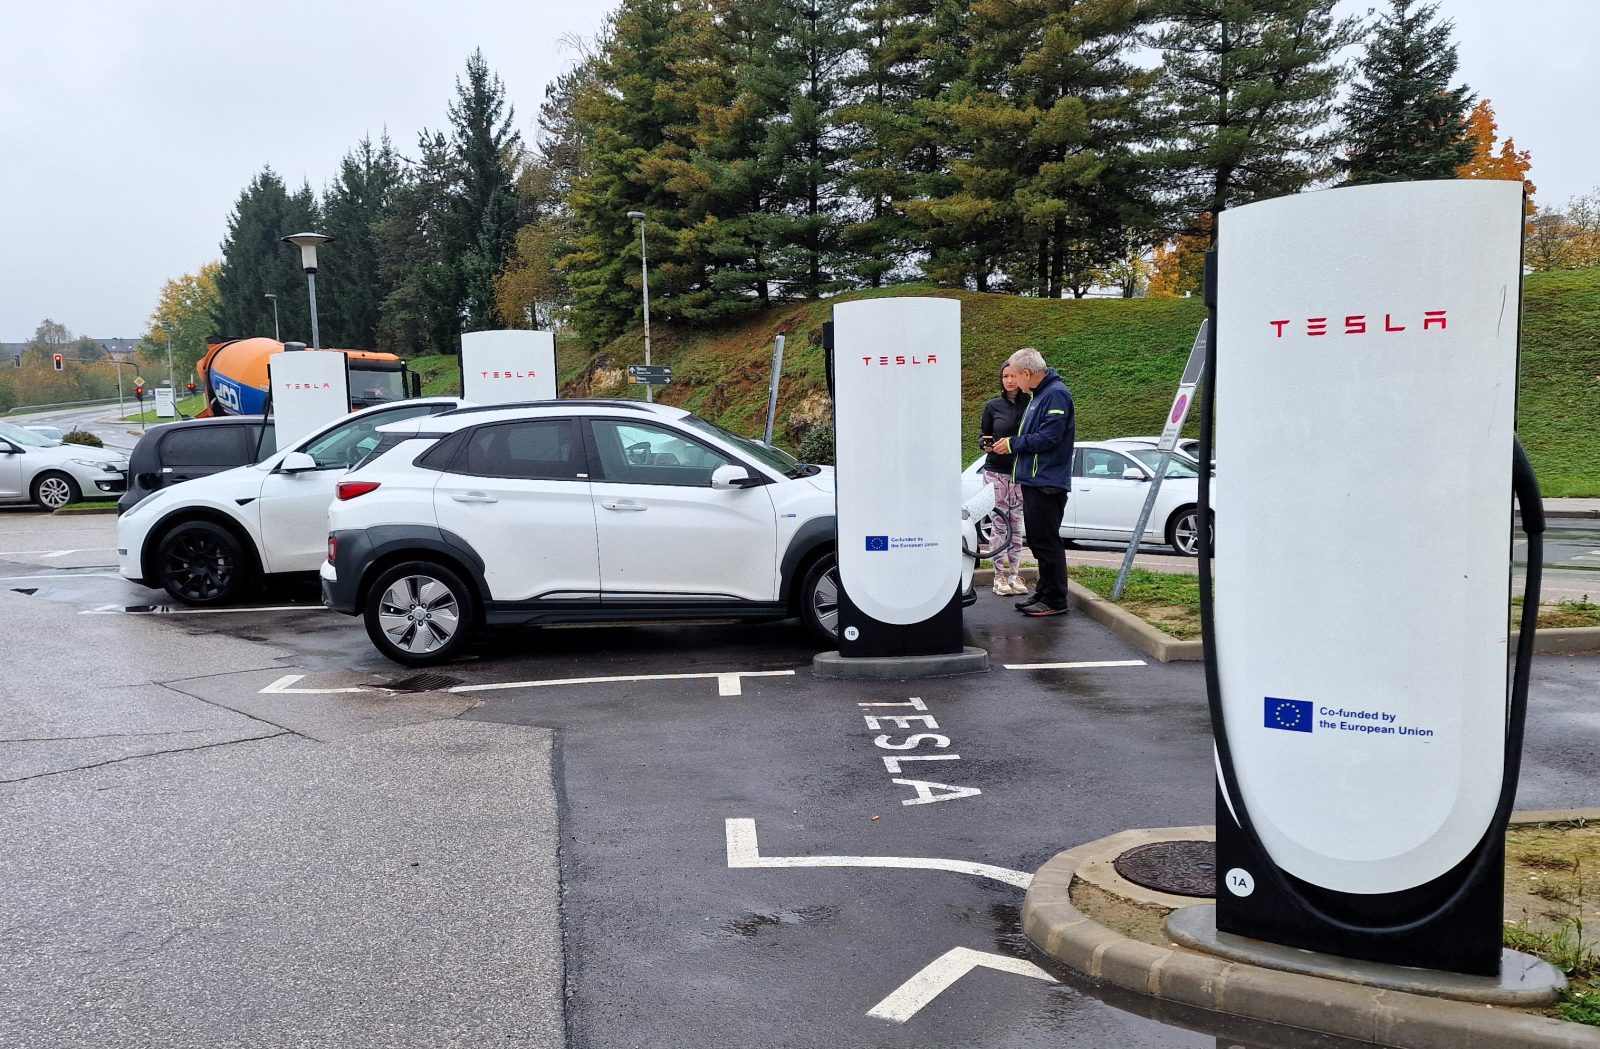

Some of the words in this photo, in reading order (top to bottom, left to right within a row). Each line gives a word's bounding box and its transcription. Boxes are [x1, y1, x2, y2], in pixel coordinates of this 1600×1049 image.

[1270, 311, 1447, 338] TESLA
[862, 355, 937, 366] TESLA
[1320, 706, 1379, 720] Co-funded
[1382, 711, 1397, 723] by
[1319, 719, 1337, 729] the
[1340, 721, 1395, 734] European
[1398, 726, 1434, 737] Union
[858, 697, 982, 806] TESLA
[1232, 876, 1248, 889] 1A
